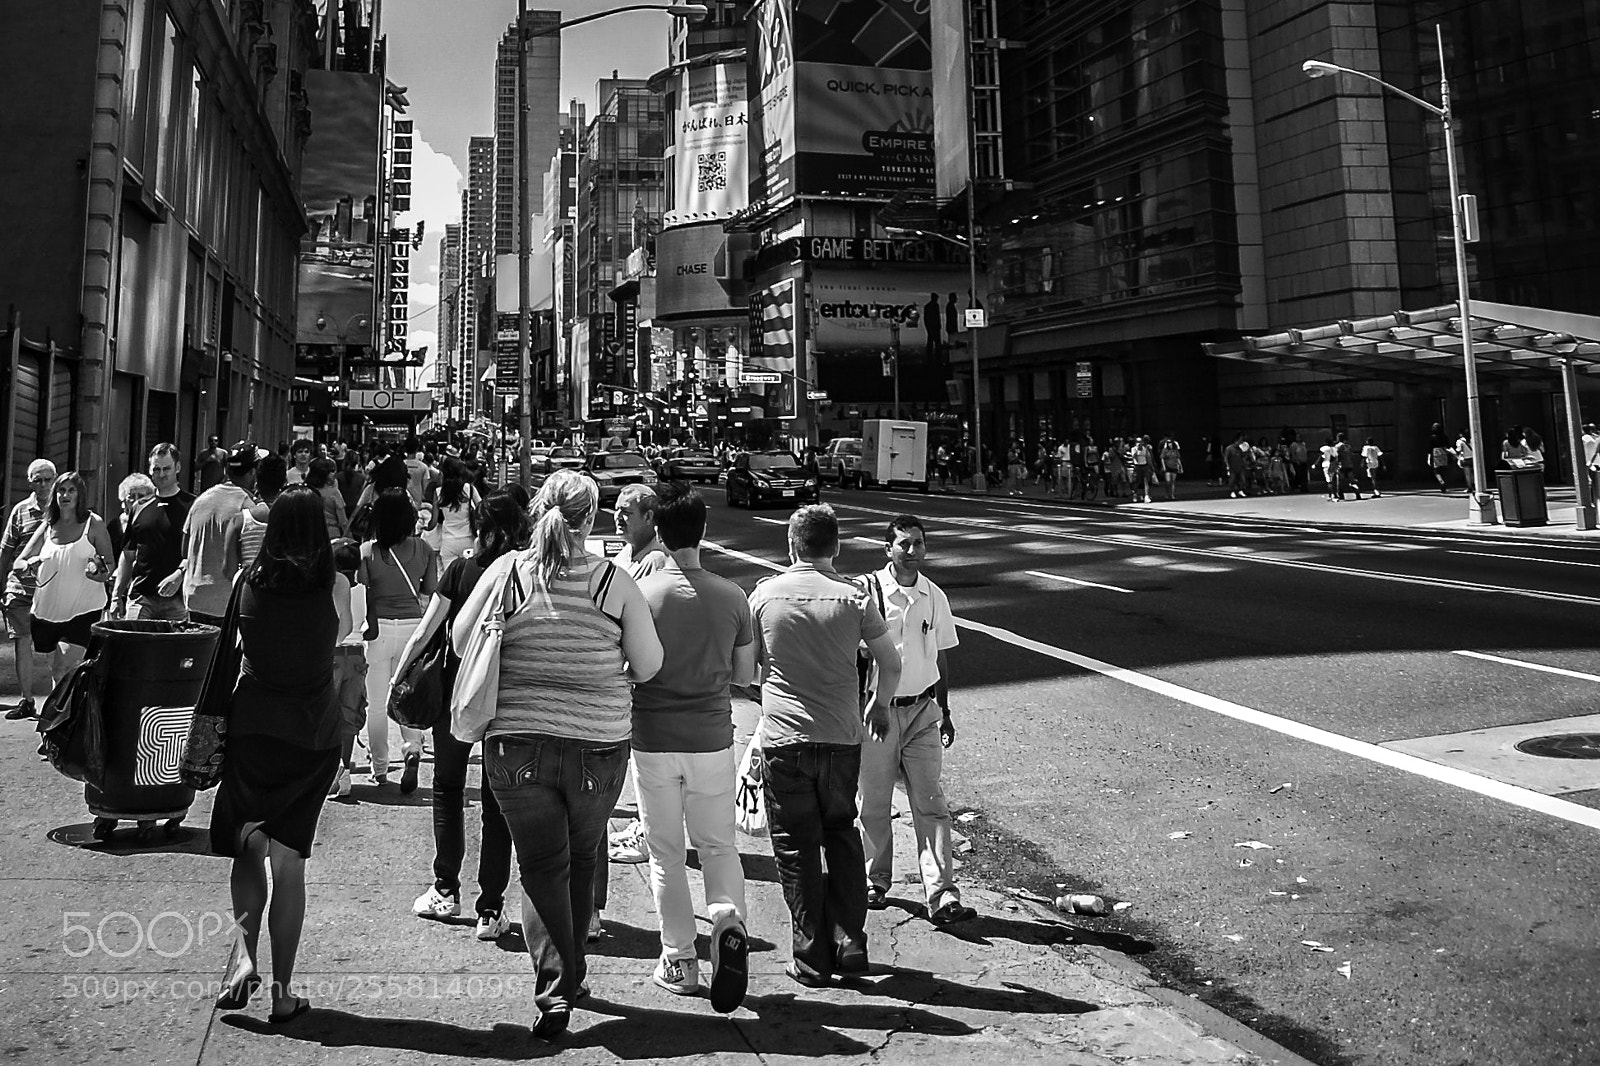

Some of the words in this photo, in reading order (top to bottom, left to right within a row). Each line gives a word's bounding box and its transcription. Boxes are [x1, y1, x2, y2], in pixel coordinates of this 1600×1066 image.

[827, 80, 880, 96] QUICK,
[884, 84, 920, 97] PICK
[870, 136, 927, 150] EMPIRE
[812, 238, 854, 259] GAME
[863, 240, 936, 261] BETWEEN
[677, 263, 707, 276] CHASE
[388, 229, 407, 351] USSAUD'S
[362, 391, 421, 409] LOFT
